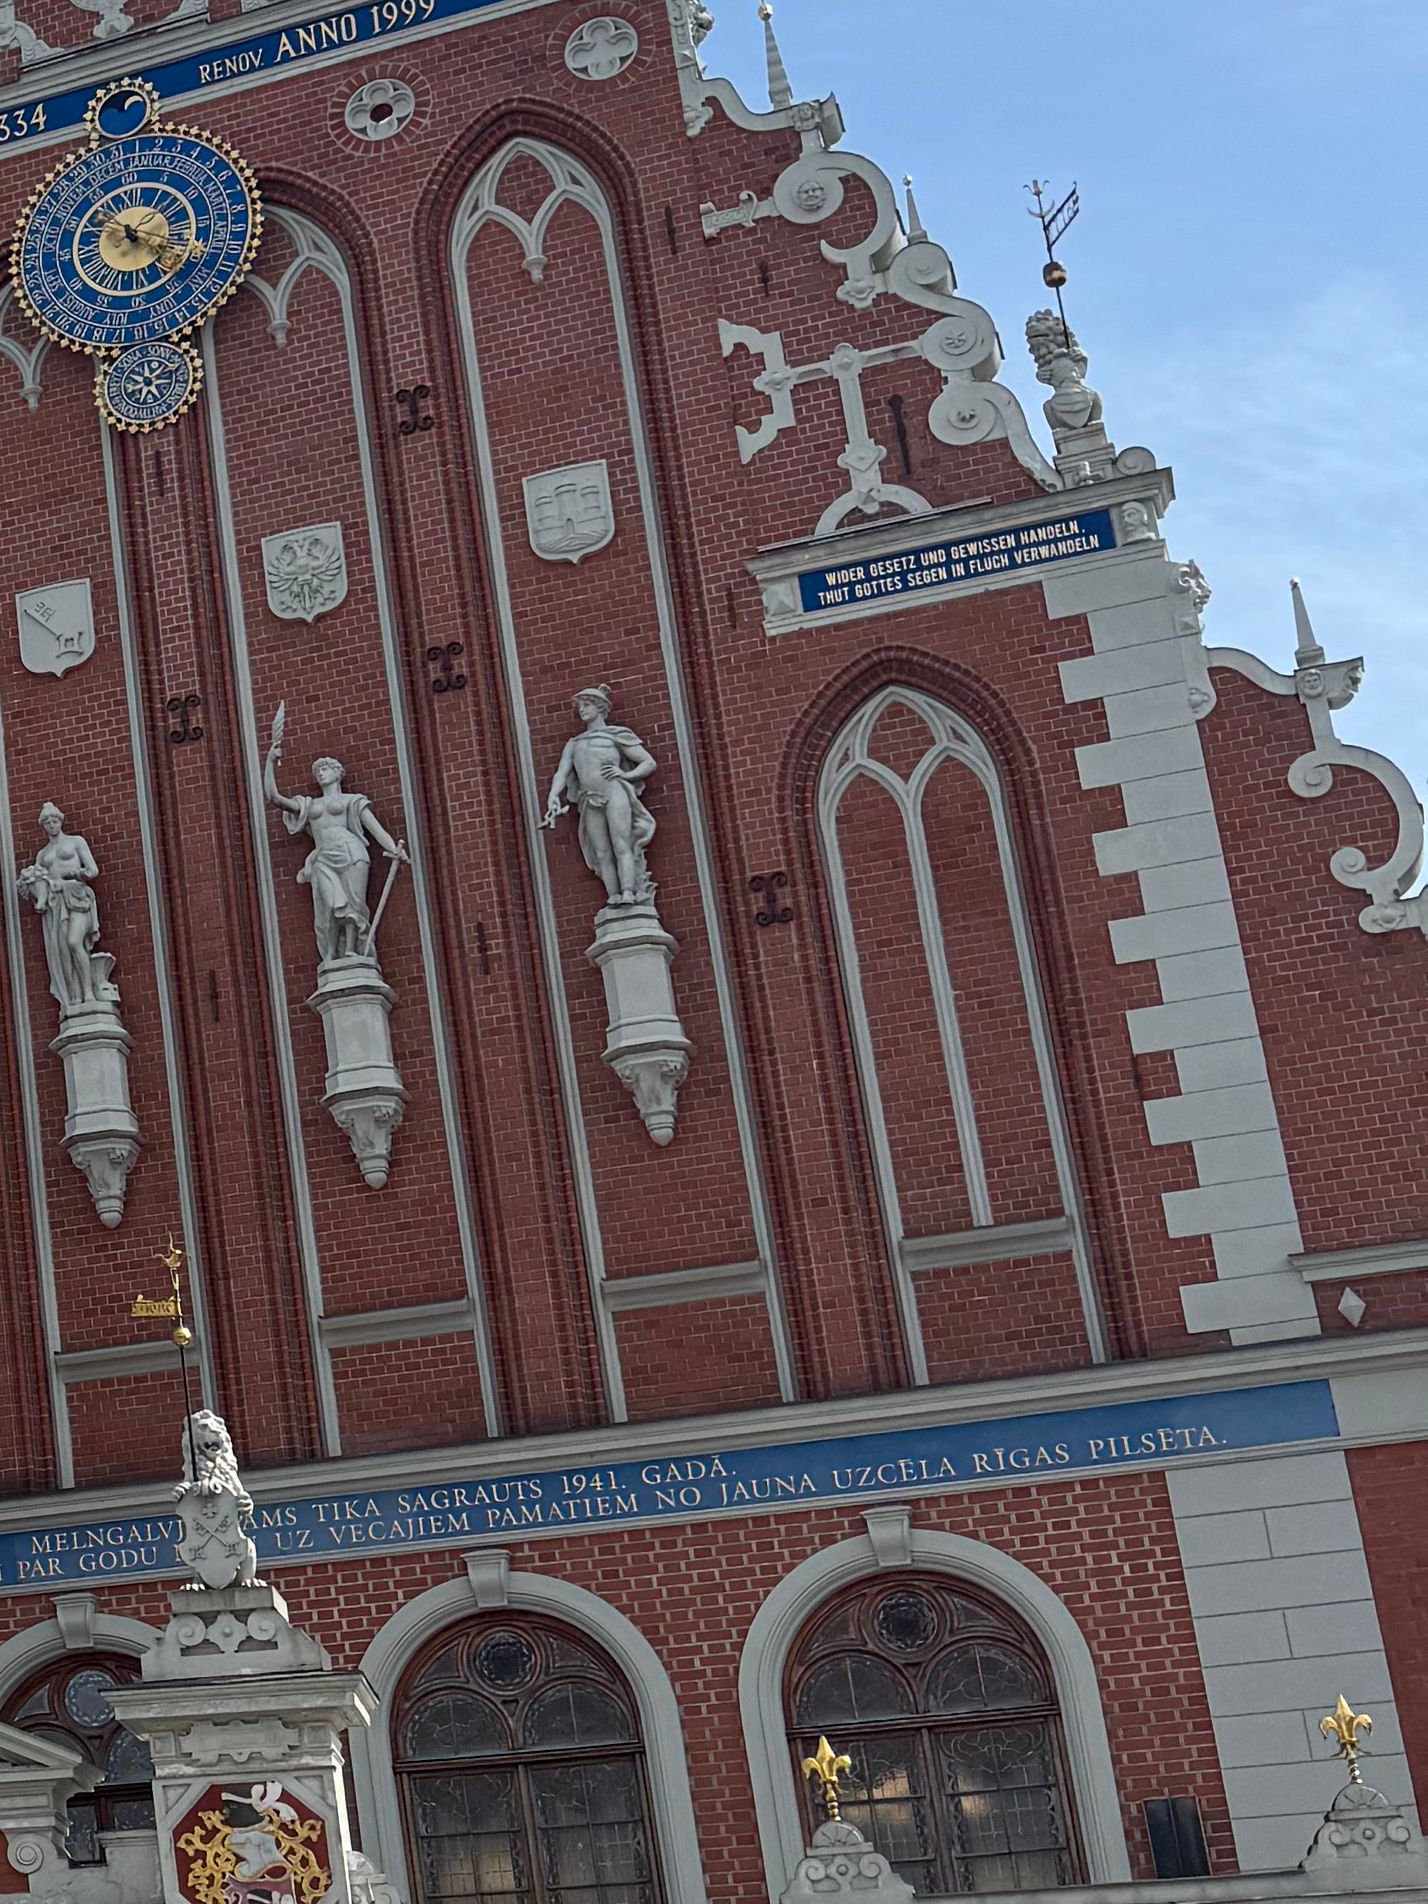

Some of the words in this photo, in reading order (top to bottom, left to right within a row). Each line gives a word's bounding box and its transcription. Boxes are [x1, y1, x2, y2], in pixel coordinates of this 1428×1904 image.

[199, 48, 264, 84] RENOV.
[274, 14, 357, 63] ANNO
[817, 587, 850, 606] THUT
[855, 575, 903, 599] GOTTES
[907, 566, 948, 586] SEGEN
[951, 562, 966, 579] IN
[969, 554, 1009, 575] FLUCH
[1013, 534, 1100, 566] VERWANDELN
[825, 566, 865, 587] WIDER
[870, 555, 917, 578] GESETZ
[920, 548, 946, 567] UND
[951, 533, 1016, 559] GEWISSEN
[19, 1558, 64, 1579] PAR
[79, 1546, 157, 1572] GODU
[275, 1529, 314, 1550] UZ
[329, 1511, 470, 1544] VECAJIEM
[487, 1493, 639, 1528] PAMATIEM
[656, 1487, 700, 1509] NO
[720, 1473, 817, 1506] JAUNA
[831, 1456, 956, 1489] UZCĒLA
[972, 1443, 1070, 1473] RĪGAS
[1088, 1426, 1226, 1460] PILSĒTA.
[32, 1519, 182, 1554] MELNGALVJ
[239, 1507, 298, 1530] AMS
[312, 1497, 380, 1522] TIKA
[397, 1479, 542, 1514] SAGRAUTS
[560, 1470, 626, 1494] 1941.
[641, 1455, 736, 1485] GADĀ.
